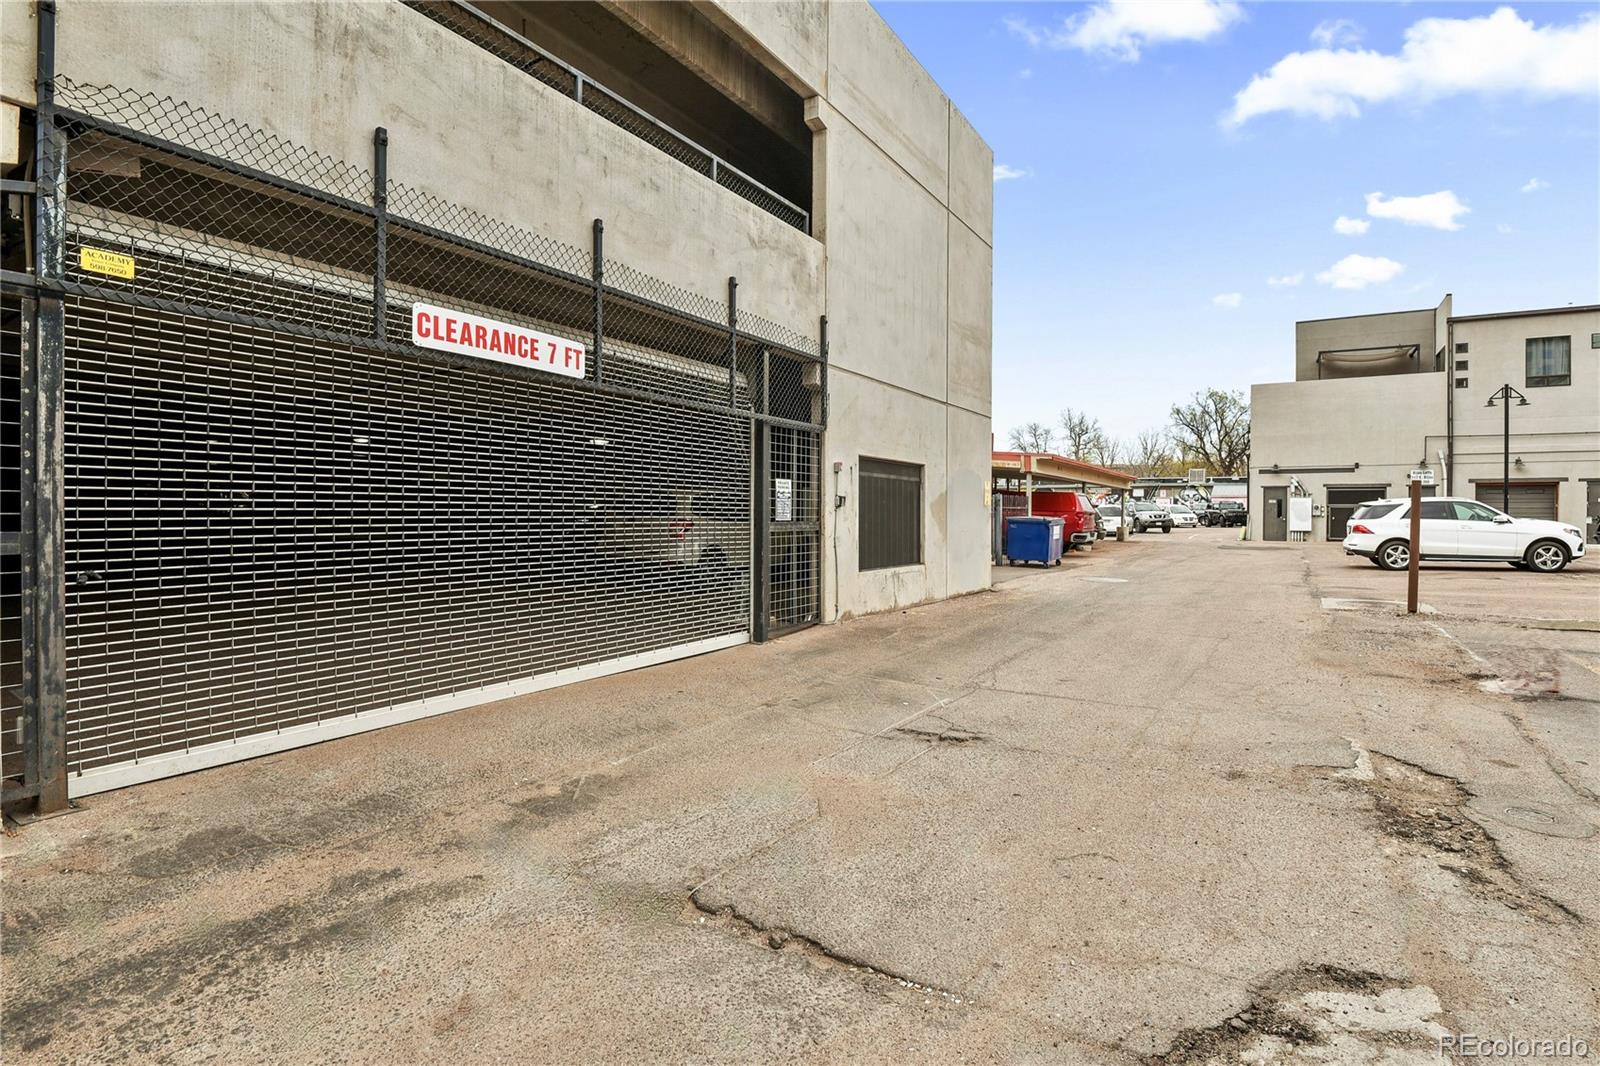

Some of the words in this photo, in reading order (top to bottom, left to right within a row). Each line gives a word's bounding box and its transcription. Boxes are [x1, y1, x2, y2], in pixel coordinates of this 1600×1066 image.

[86, 251, 131, 265] ACADEMY
[416, 312, 540, 361] CLEARANCE
[547, 342, 557, 364] 7
[564, 347, 582, 370] FT
